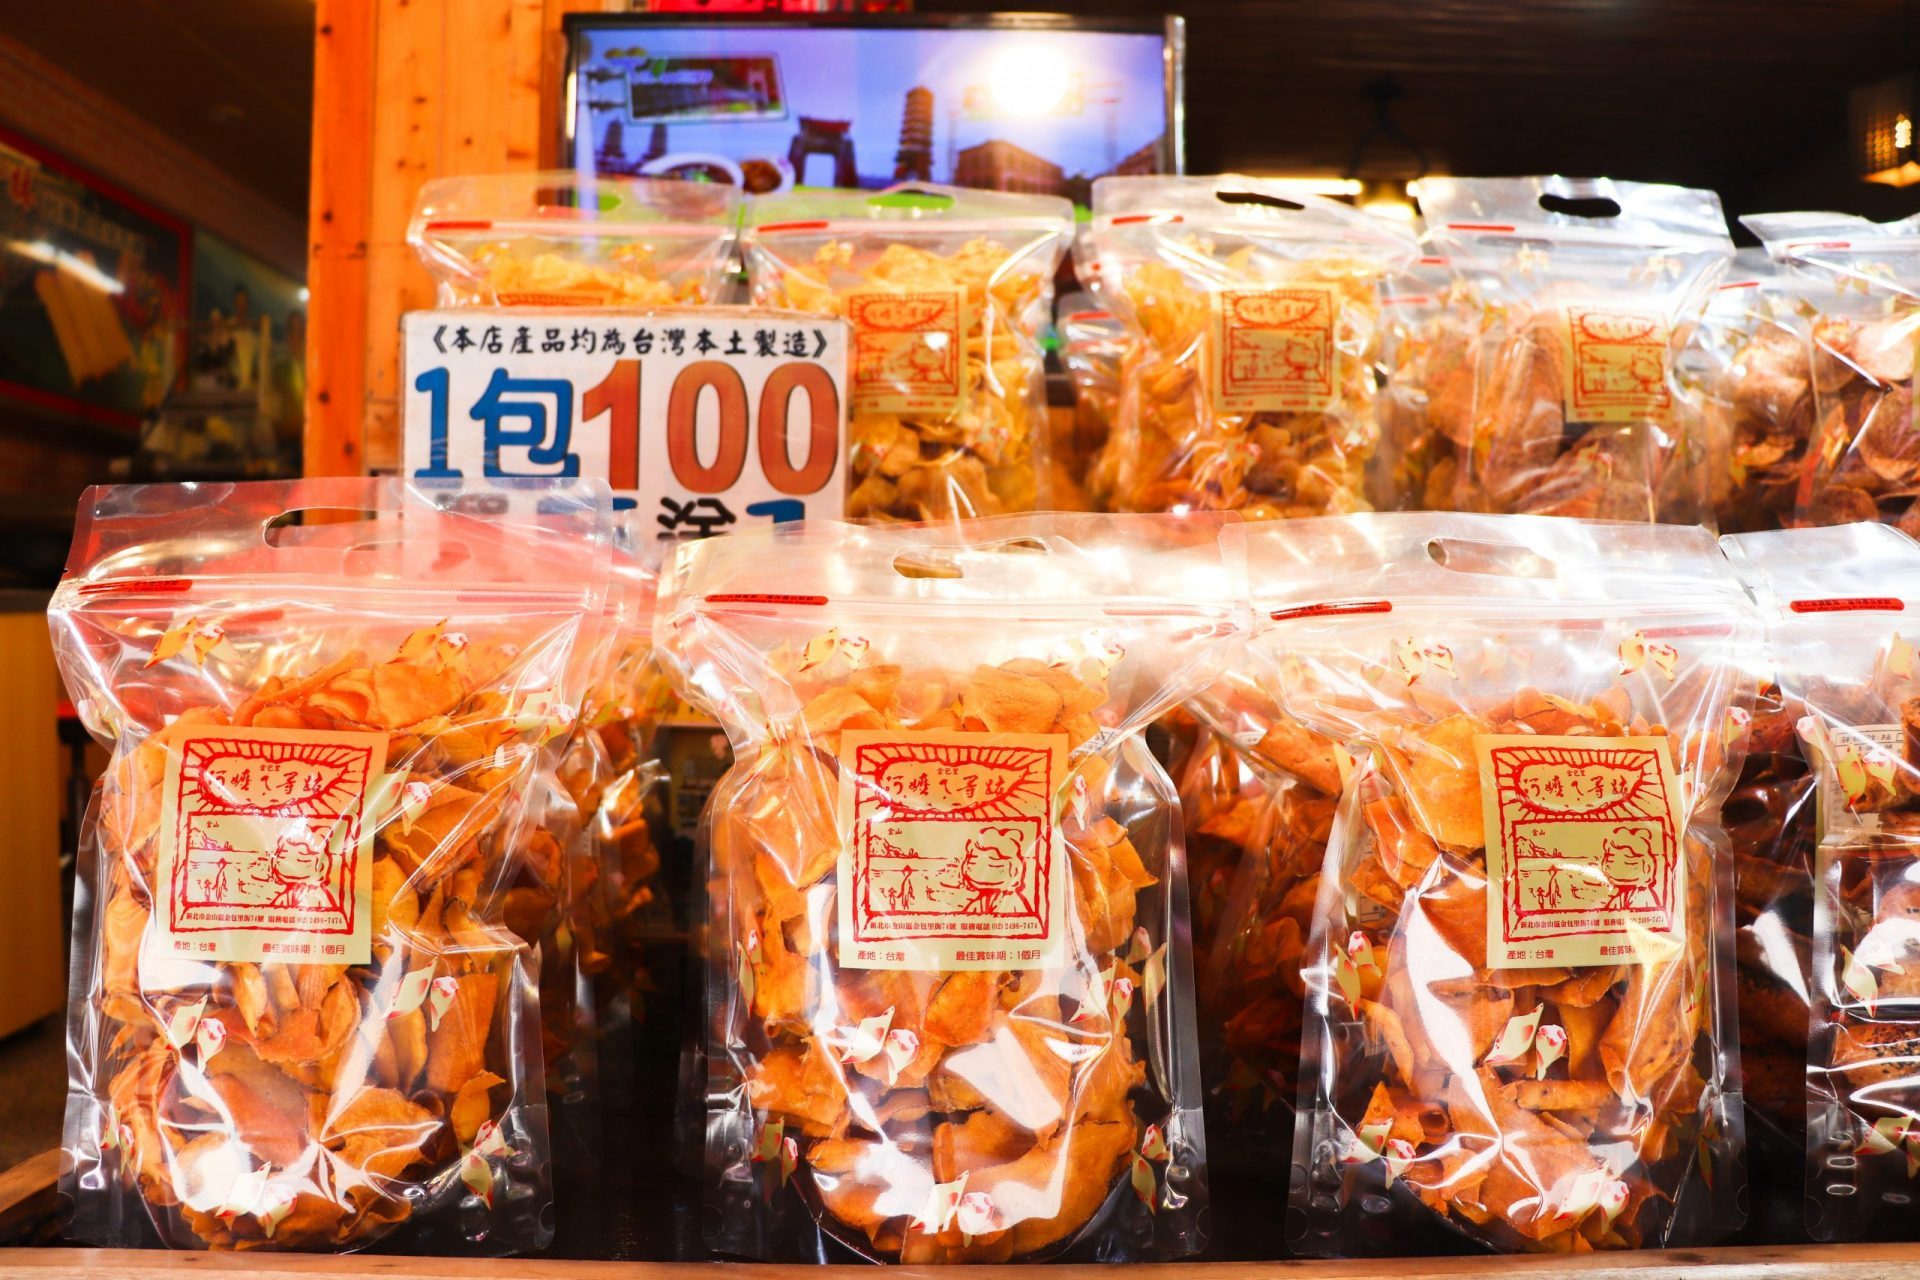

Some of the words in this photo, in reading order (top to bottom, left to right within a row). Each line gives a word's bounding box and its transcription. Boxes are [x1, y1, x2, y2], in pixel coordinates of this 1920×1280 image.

[432, 325, 827, 359] 《本店產品均為台灣本土製造》
